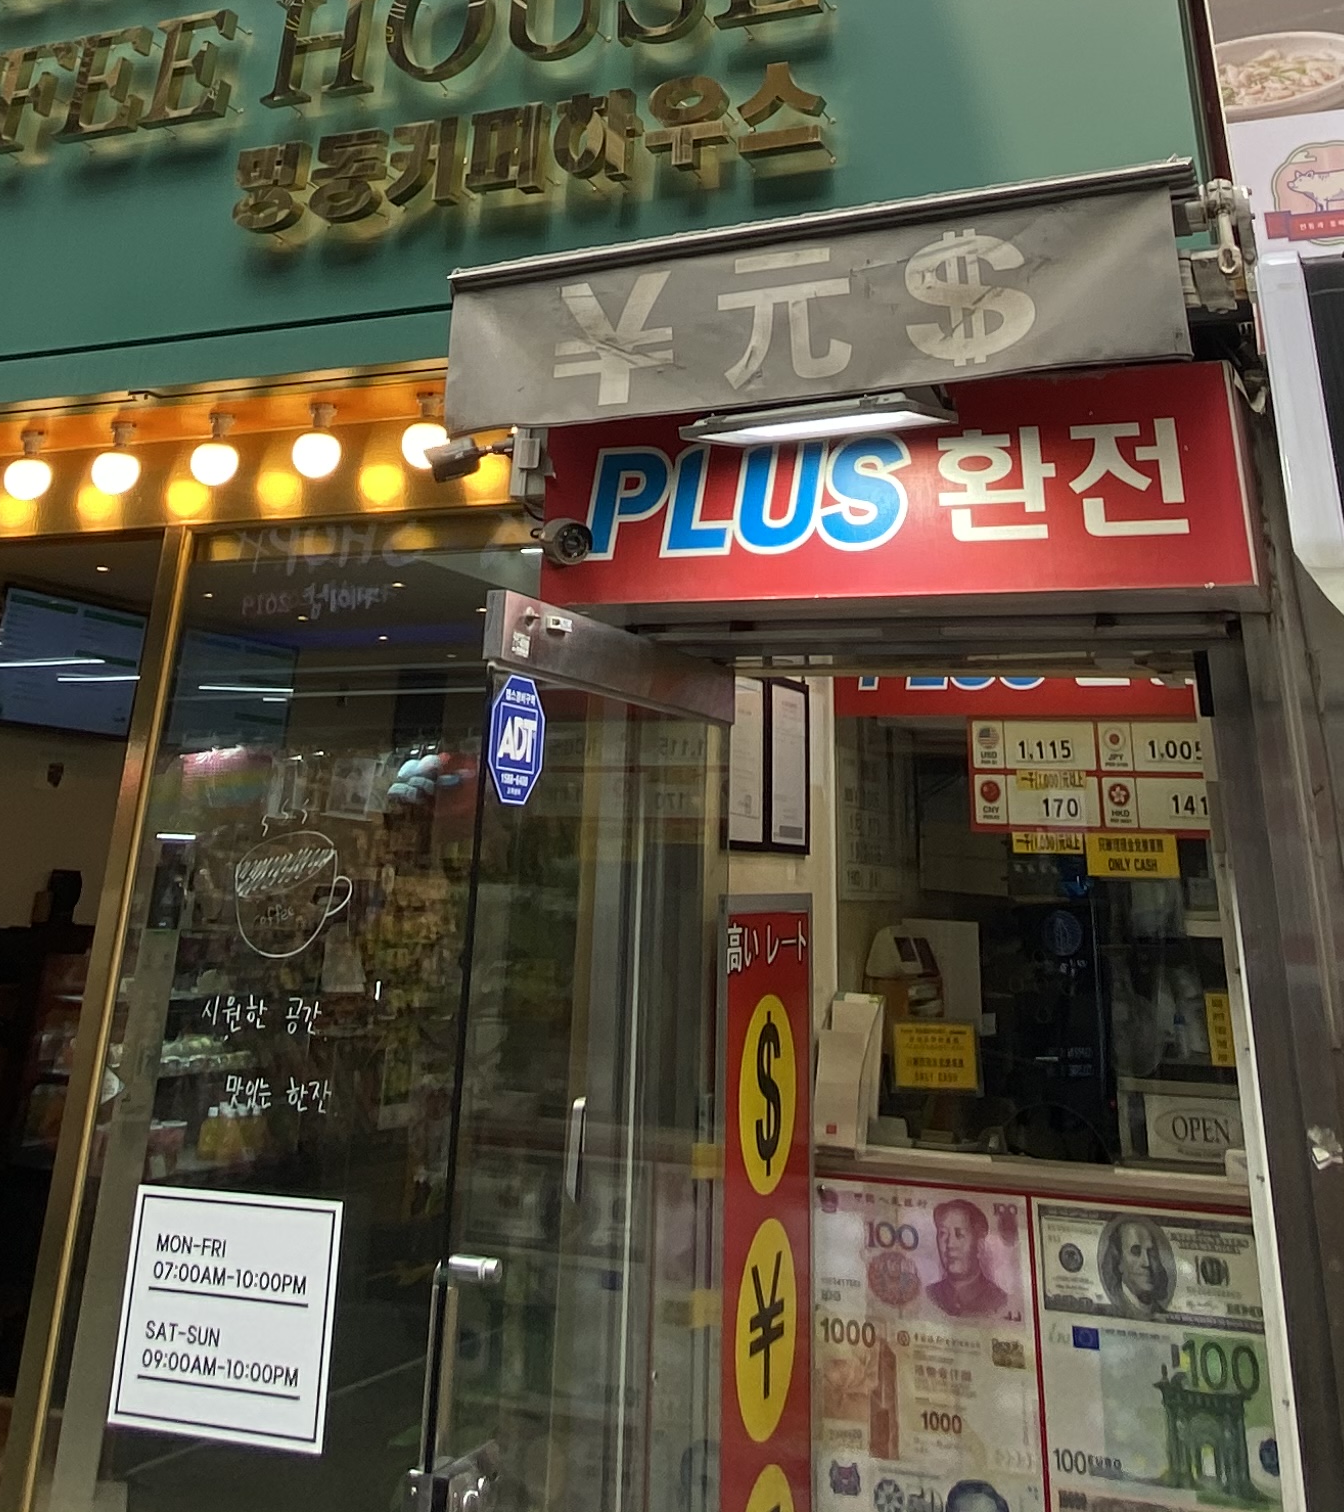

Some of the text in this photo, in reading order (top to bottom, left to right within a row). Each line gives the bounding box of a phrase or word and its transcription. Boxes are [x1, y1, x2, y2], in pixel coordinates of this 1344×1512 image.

[231, 62, 839, 236] 명동커피하우스
[718, 246, 854, 391] 元
[904, 228, 1037, 367] $
[583, 415, 1191, 562] PLUS 환전
[497, 716, 538, 764] ADT
[980, 750, 998, 760] USD
[1018, 739, 1073, 761] 1,115
[1042, 796, 1080, 819] 170
[1111, 809, 1130, 818] HKD
[1108, 857, 1158, 873] ONLY CASH
[201, 992, 325, 1037] 시원한 공간
[225, 1072, 335, 1116] 맛있는 한잔
[756, 1010, 782, 1177] $
[1172, 1116, 1232, 1145] OPEN
[156, 1232, 227, 1259] MON-FRI
[866, 1220, 920, 1252] 100
[152, 1260, 307, 1295] 07:00AM-10:00PM
[145, 1320, 221, 1348] SAT-SUN
[748, 1250, 785, 1401] ¥
[820, 1316, 877, 1349] 1000
[141, 1348, 300, 1388] 09:00AM-10:00PM
[1179, 1339, 1261, 1396] 100
[921, 1410, 963, 1435] 1000
[1053, 1447, 1087, 1475] 100
